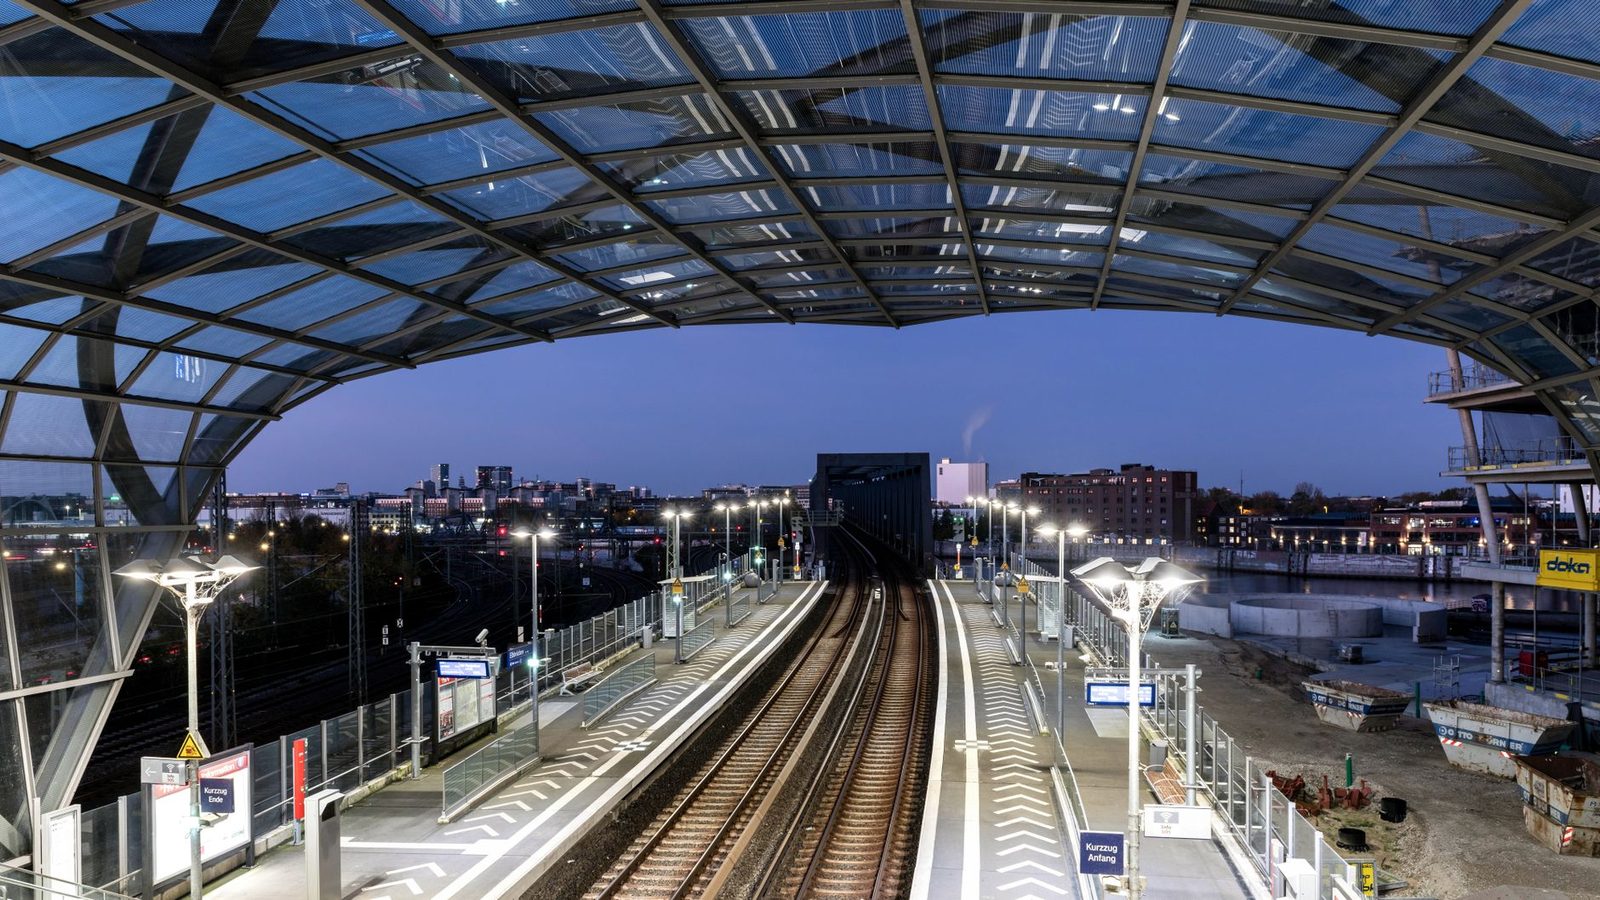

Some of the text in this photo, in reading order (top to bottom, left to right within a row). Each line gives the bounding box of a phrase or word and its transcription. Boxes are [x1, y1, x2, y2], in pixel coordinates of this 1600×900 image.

[1546, 556, 1590, 574] doka
[1447, 728, 1473, 741] OTTO
[204, 786, 228, 796] Kurzzug
[1086, 843, 1118, 853] Kurzzug
[1088, 854, 1116, 864] Anfang
